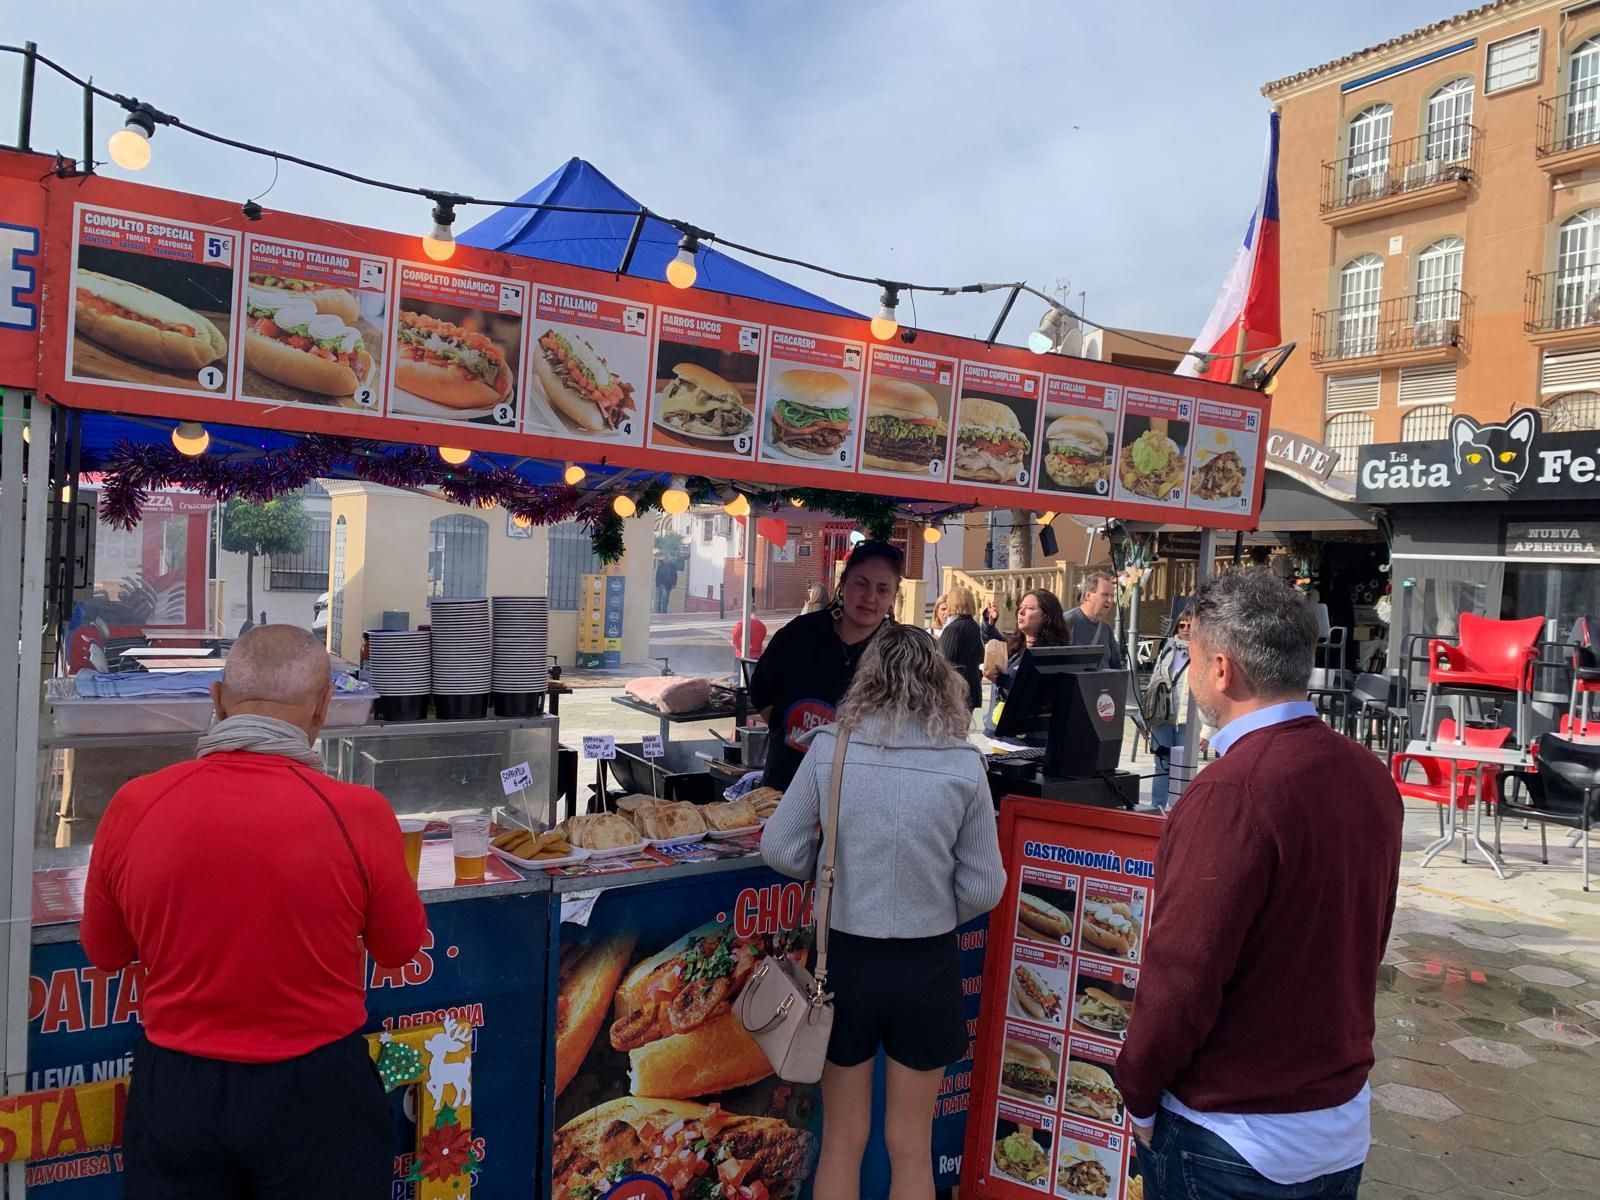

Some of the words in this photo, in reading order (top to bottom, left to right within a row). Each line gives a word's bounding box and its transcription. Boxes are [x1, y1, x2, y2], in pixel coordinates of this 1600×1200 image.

[84, 213, 144, 233] COMPLETO
[146, 223, 195, 242] ESPECIAL
[125, 230, 151, 244] TOMATE
[208, 237, 230, 258] 5€
[252, 242, 304, 261] COMPLETO
[306, 252, 349, 268] ITALIANO
[403, 270, 449, 285] COMPLETO
[451, 276, 496, 293] DINÁMICO
[539, 291, 553, 305] AS
[555, 295, 598, 313] ITALIANO
[663, 314, 695, 329] BARROS
[696, 320, 722, 333] LUCOS
[911, 357, 936, 369] ITALIANO
[207, 372, 214, 385] 1
[989, 370, 1020, 383] COMPLETO
[361, 390, 370, 403] 2
[499, 407, 508, 420] 3
[624, 423, 631, 435] 4
[739, 438, 746, 449] 5
[840, 450, 846, 462] 6
[1389, 451, 1409, 463] La
[933, 462, 939, 472] 7
[1362, 458, 1451, 489] Gata
[1019, 472, 1026, 482] 8
[1099, 481, 1105, 491] 9
[1172, 489, 1180, 499] 10
[1240, 496, 1247, 507] 11
[1527, 528, 1581, 539] NUEVA
[1513, 541, 1595, 553] APERTURA
[1024, 840, 1122, 874] GASTRONOMÍA
